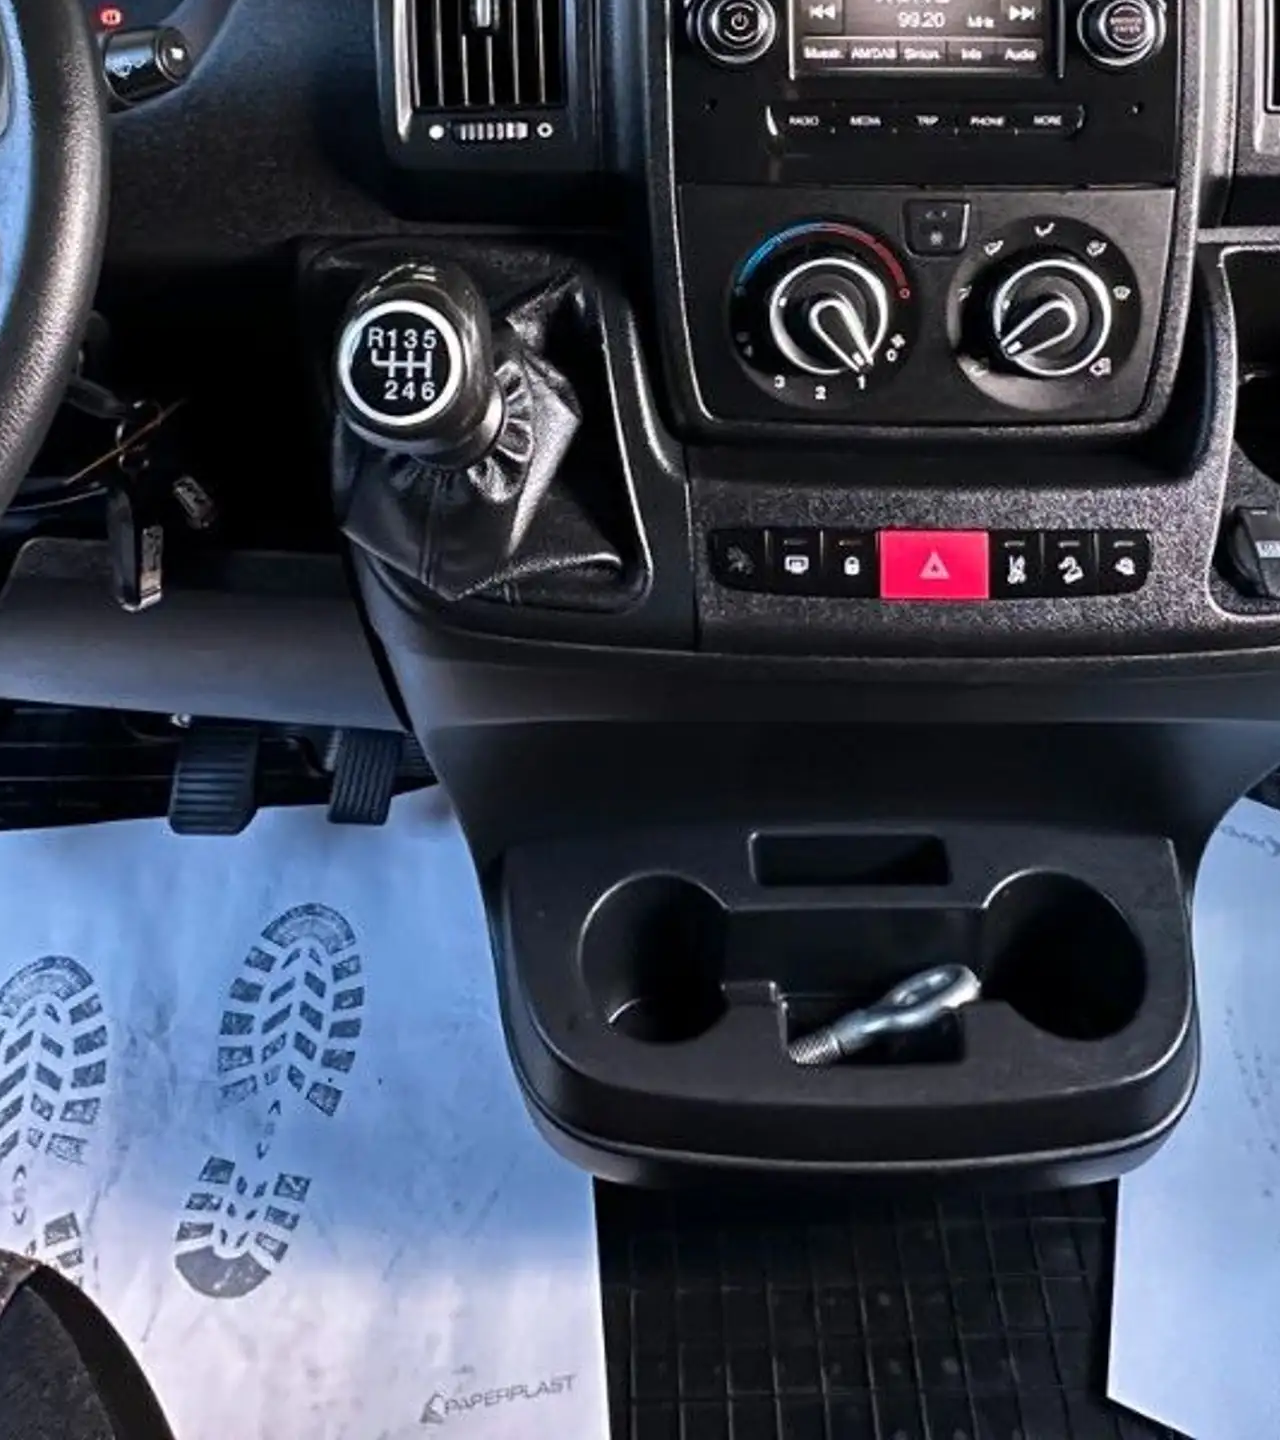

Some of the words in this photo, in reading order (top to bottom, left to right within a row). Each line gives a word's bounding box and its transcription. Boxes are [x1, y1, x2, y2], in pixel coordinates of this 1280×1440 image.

[1005, 48, 1037, 60] Audio
[789, 116, 819, 125] RADIO
[850, 116, 881, 126] MEDIA
[916, 116, 939, 125] TRIP
[971, 116, 1004, 126] PHONE
[1033, 116, 1062, 125] MORE
[367, 328, 384, 348] R
[403, 329, 418, 348] 3
[422, 329, 437, 348] 5
[384, 380, 399, 400] 2
[402, 381, 416, 401] 4
[421, 382, 435, 401] 6
[445, 1373, 577, 1415] PAPERPLAST
